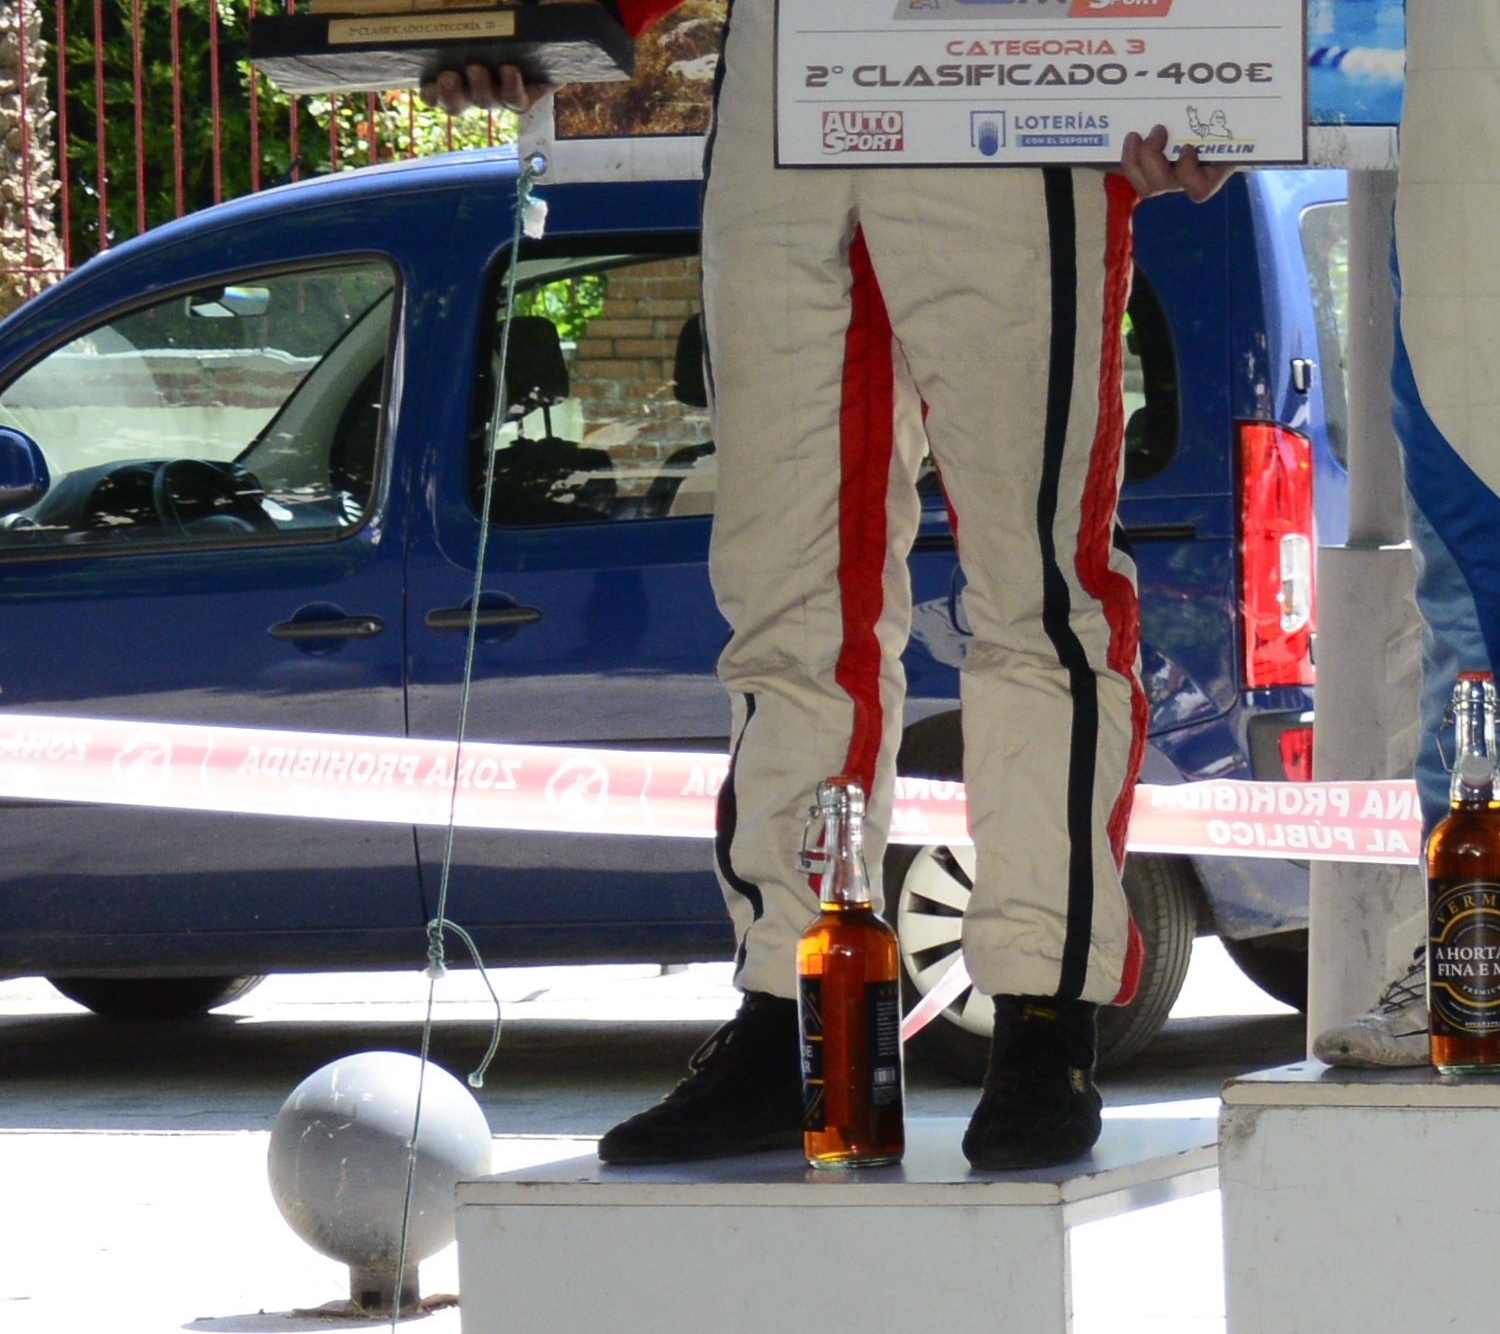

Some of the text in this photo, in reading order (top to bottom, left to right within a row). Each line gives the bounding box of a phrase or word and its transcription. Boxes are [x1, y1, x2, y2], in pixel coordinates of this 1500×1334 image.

[945, 39, 1146, 57] CATEGORIA 3
[805, 64, 843, 88] 2º
[853, 63, 1128, 87] CLASIFICADO
[1157, 62, 1273, 85] 400€
[822, 111, 903, 133] AUTO
[1014, 111, 1110, 131] LOTERÍAS
[821, 128, 904, 154] SPORT
[1024, 136, 1099, 145] CON EL DEPORTE
[1172, 143, 1256, 155] MCHELIN
[1435, 947, 1444, 960] A
[1437, 963, 1475, 977] FINA
[1479, 962, 1490, 976] E
